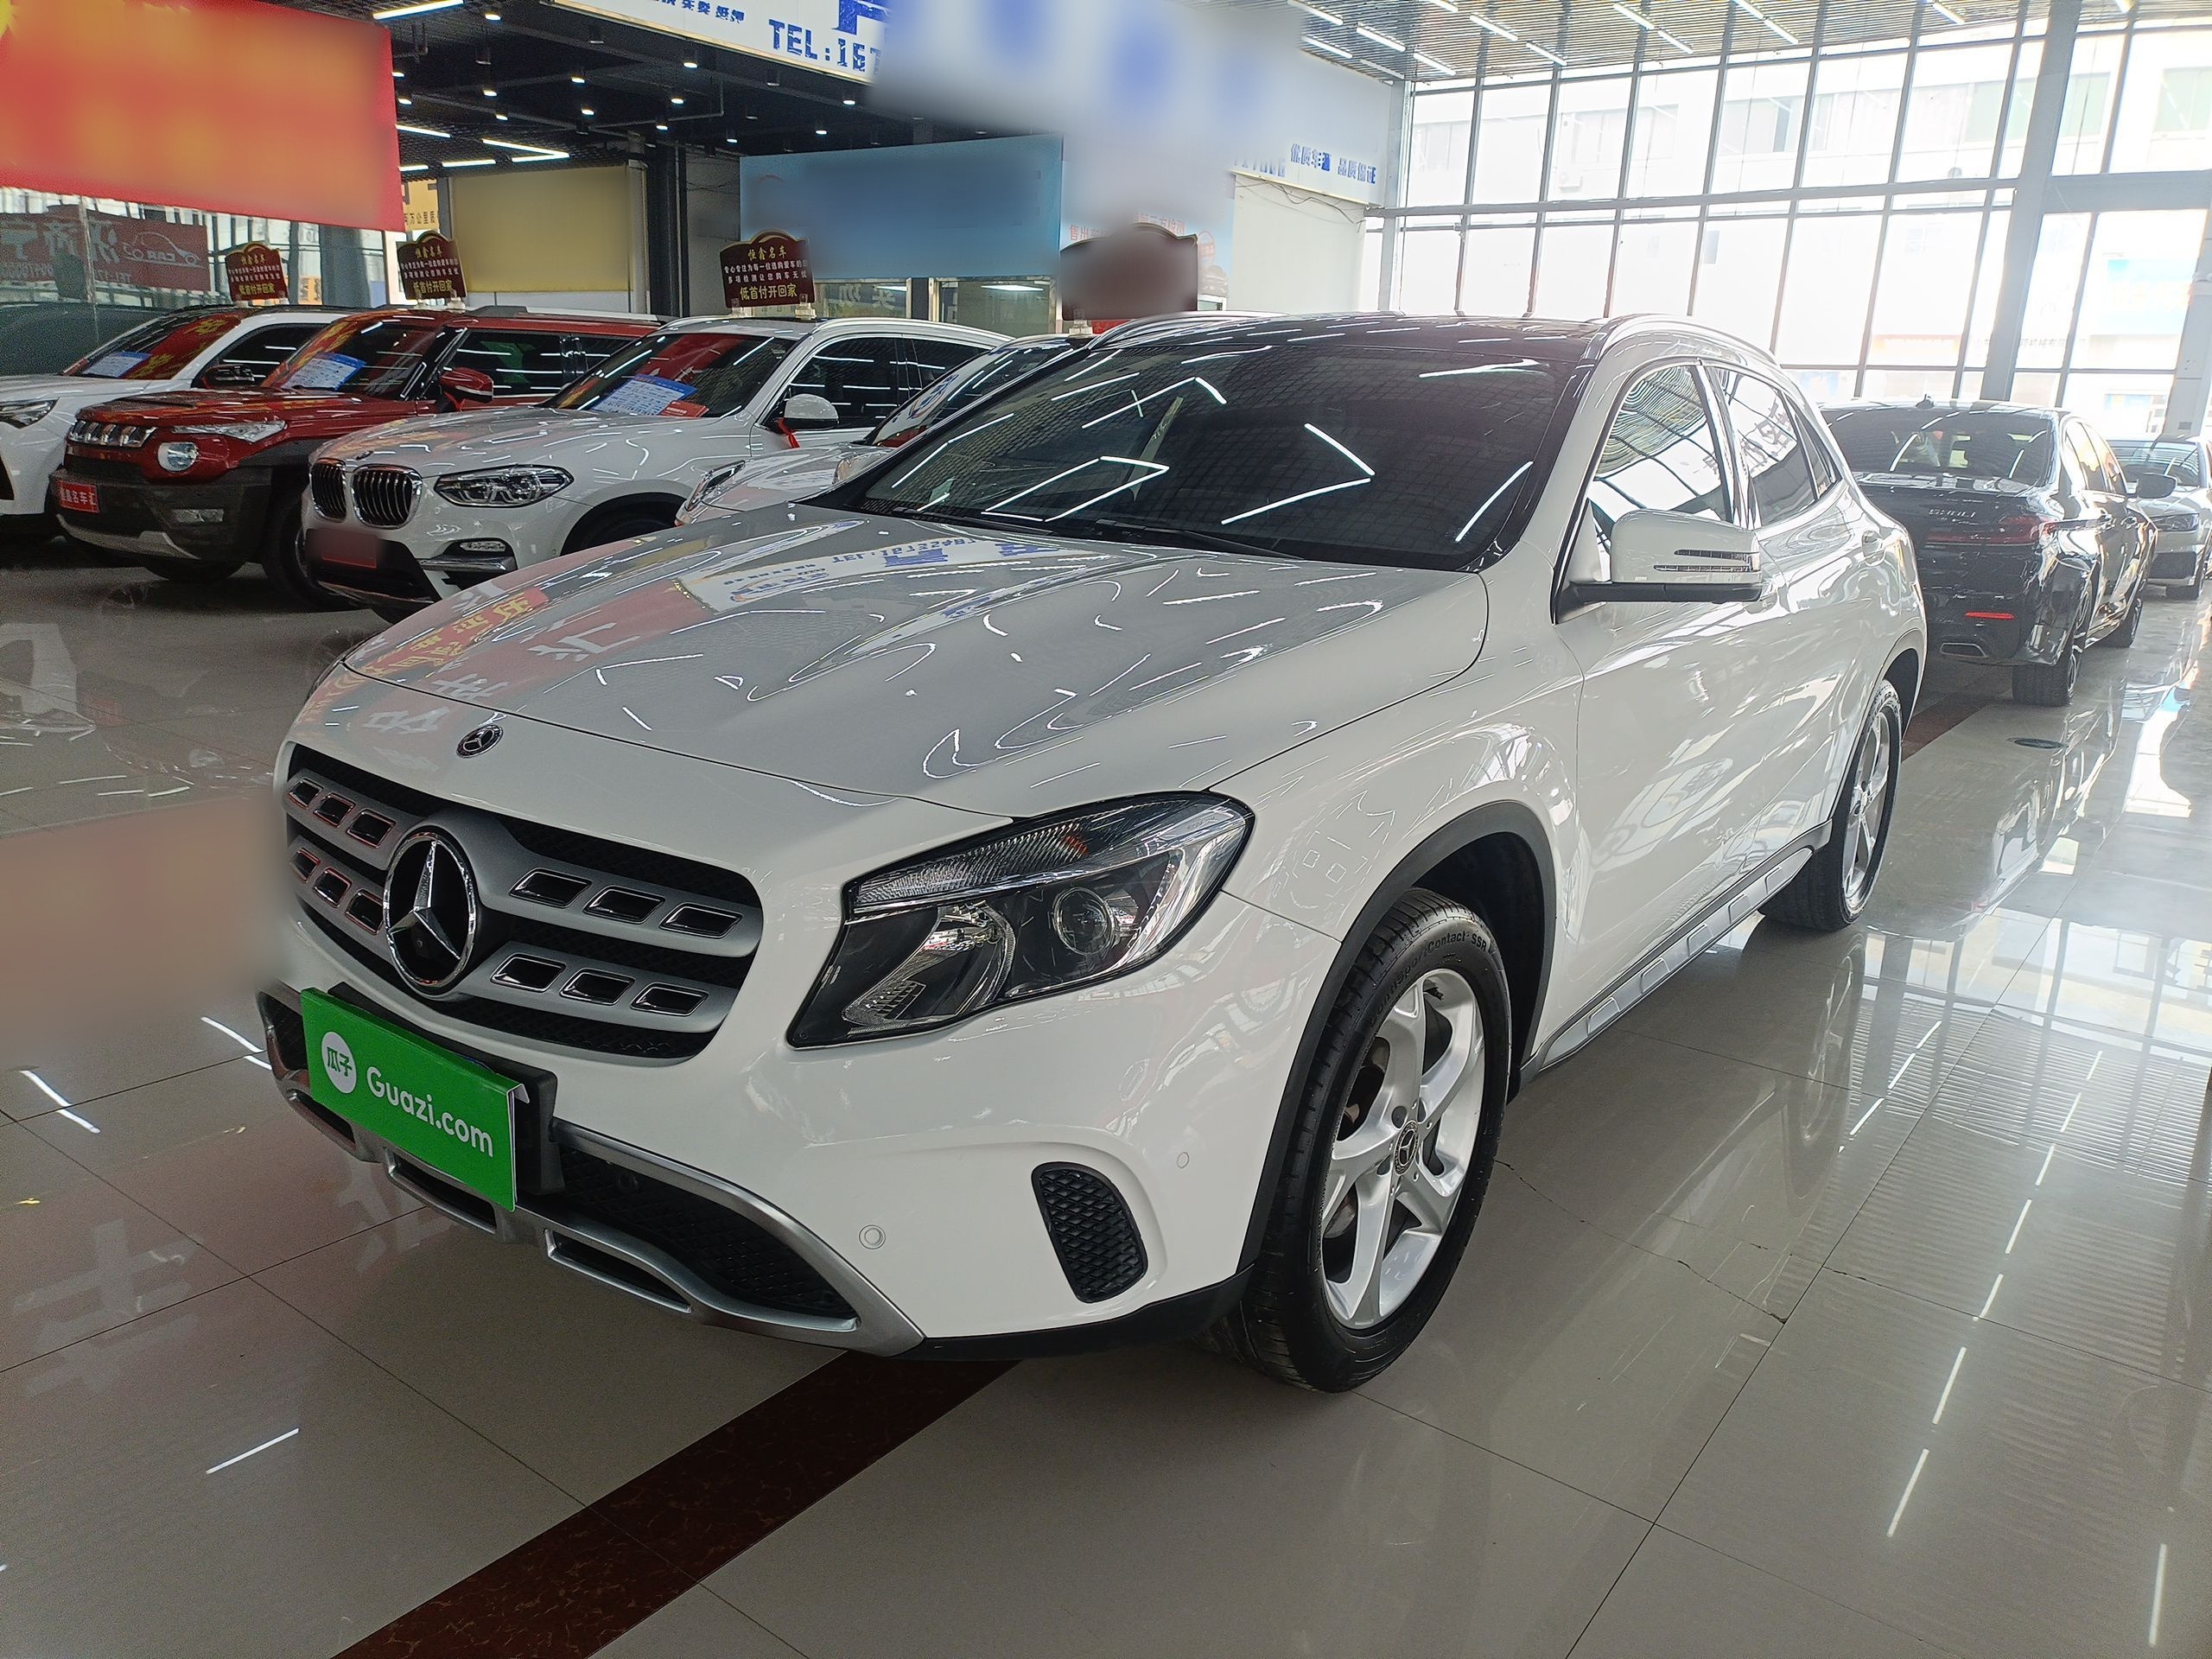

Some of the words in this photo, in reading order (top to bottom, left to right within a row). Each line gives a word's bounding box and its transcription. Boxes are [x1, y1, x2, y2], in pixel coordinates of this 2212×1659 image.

[740, 283, 798, 301] 低首付开回家
[1471, 933, 1487, 952] SSR
[327, 1046, 353, 1077] 瓜子
[366, 1066, 493, 1157] Guazi.com
